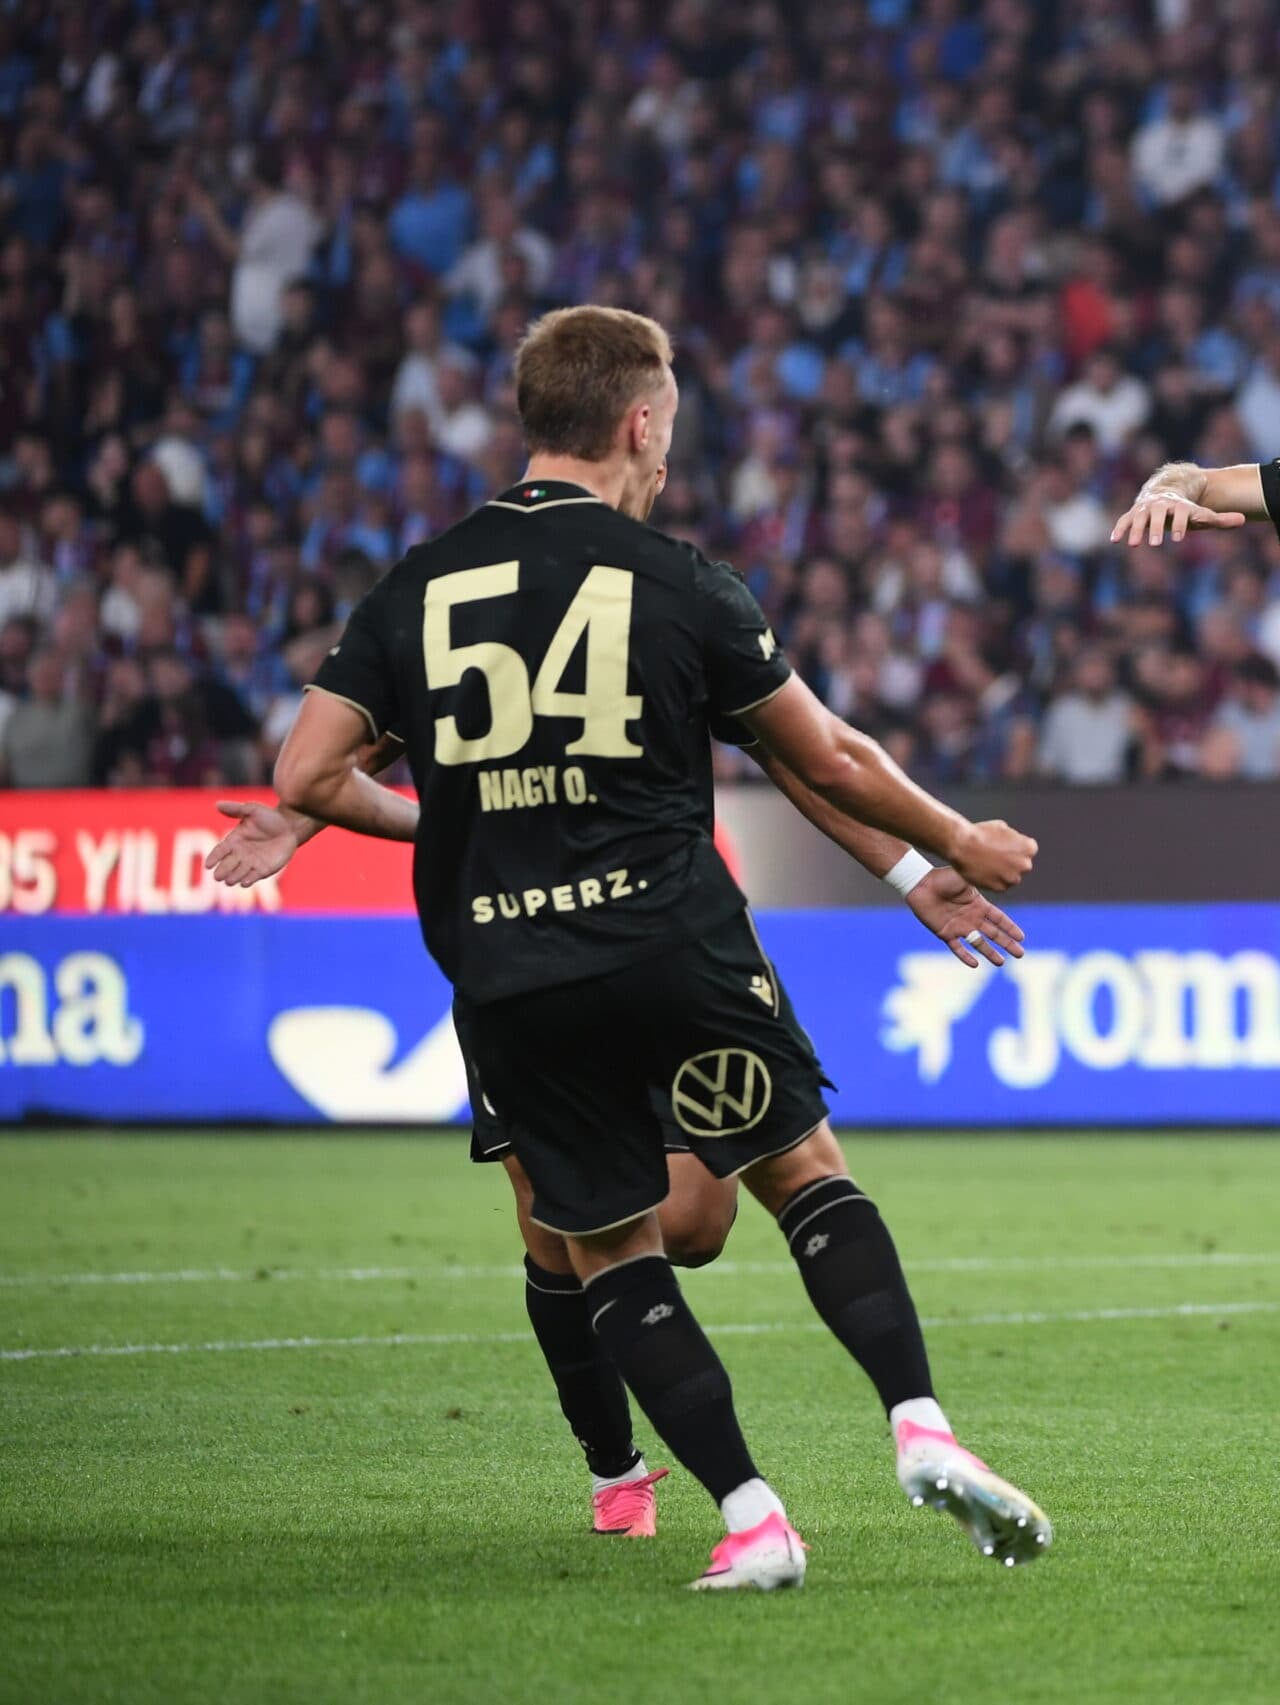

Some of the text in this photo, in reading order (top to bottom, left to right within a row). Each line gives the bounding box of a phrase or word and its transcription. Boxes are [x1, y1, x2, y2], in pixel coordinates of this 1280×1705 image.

[423, 559, 644, 766] 54
[478, 766, 598, 812] NAGY O.
[471, 869, 648, 924] SUPERZ.
